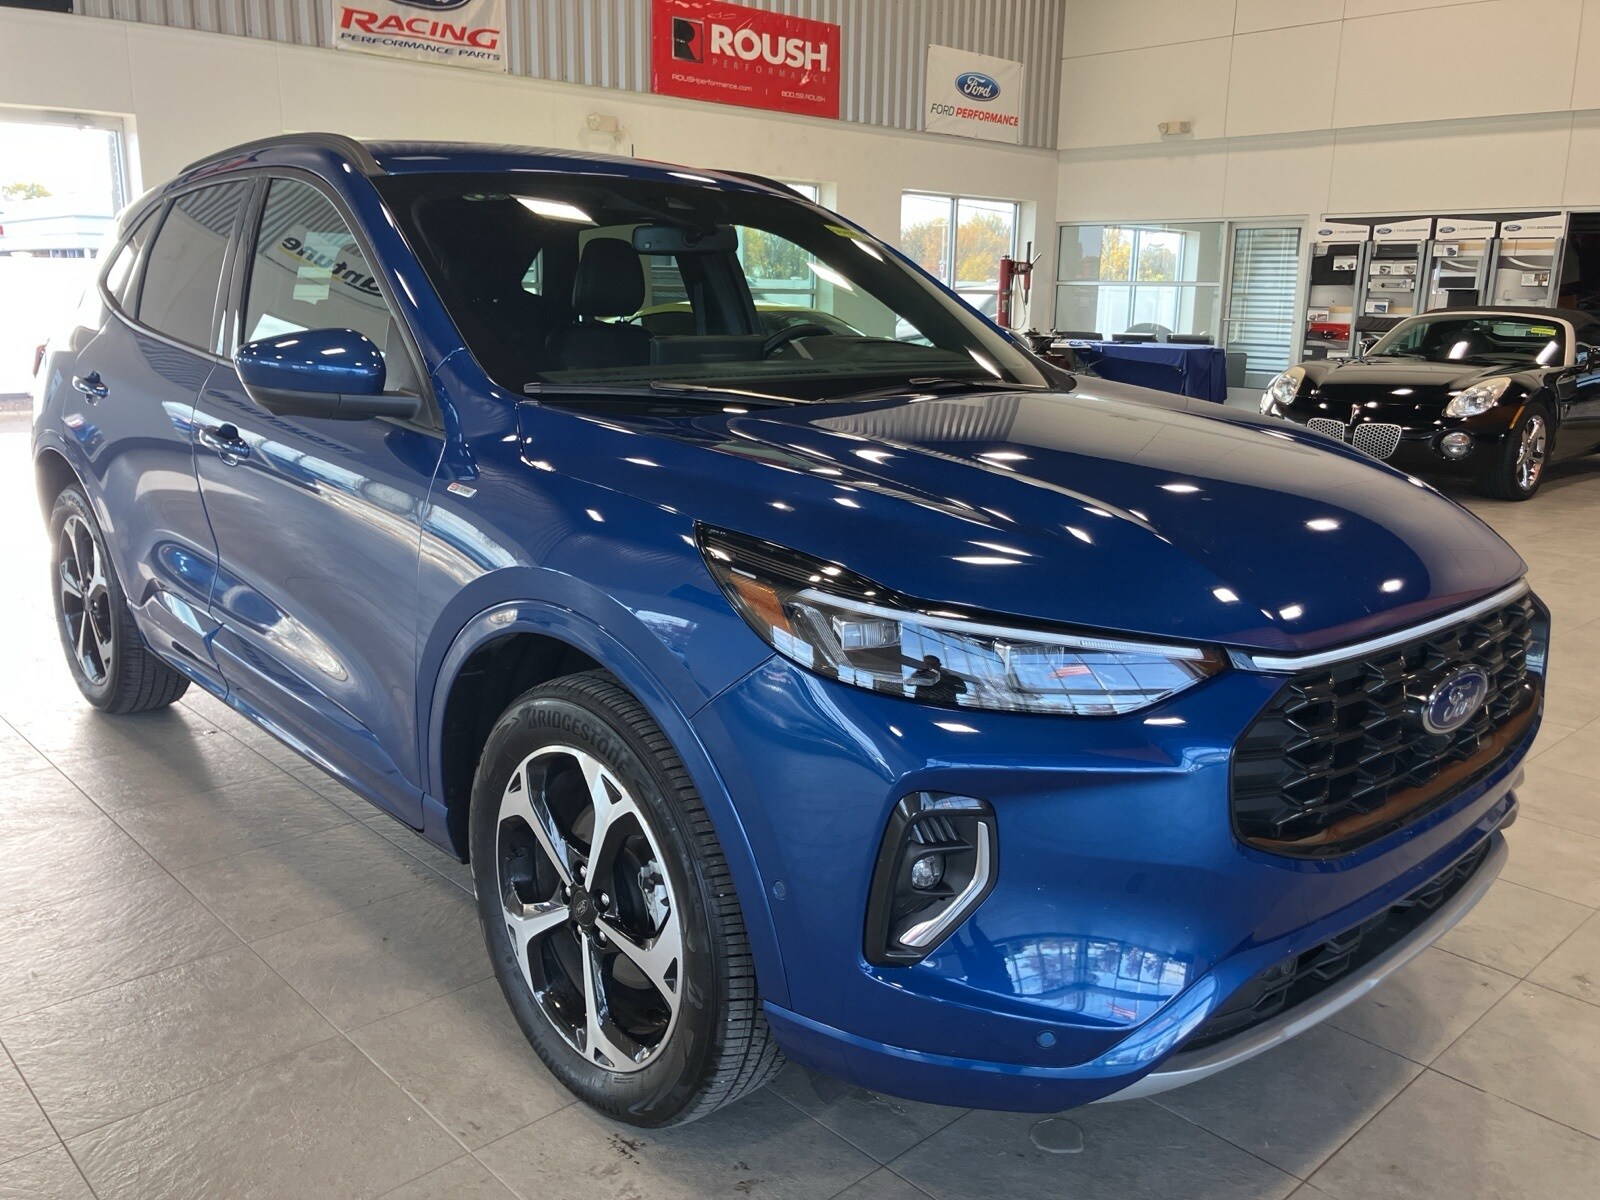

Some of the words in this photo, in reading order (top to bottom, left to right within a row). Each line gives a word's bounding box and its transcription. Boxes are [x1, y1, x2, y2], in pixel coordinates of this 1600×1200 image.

[340, 6, 500, 50] RACING
[340, 32, 454, 56] PERFORMANCE
[458, 49, 501, 61] PARTS
[711, 24, 828, 72] ROUSH
[712, 58, 827, 84] PERFORMANCE
[963, 76, 992, 97] Ford
[930, 103, 955, 116] FORD
[956, 107, 1018, 126] PERFORMANCE
[1444, 681, 1479, 722] Ford
[526, 707, 631, 778] BRIDGESTONE
